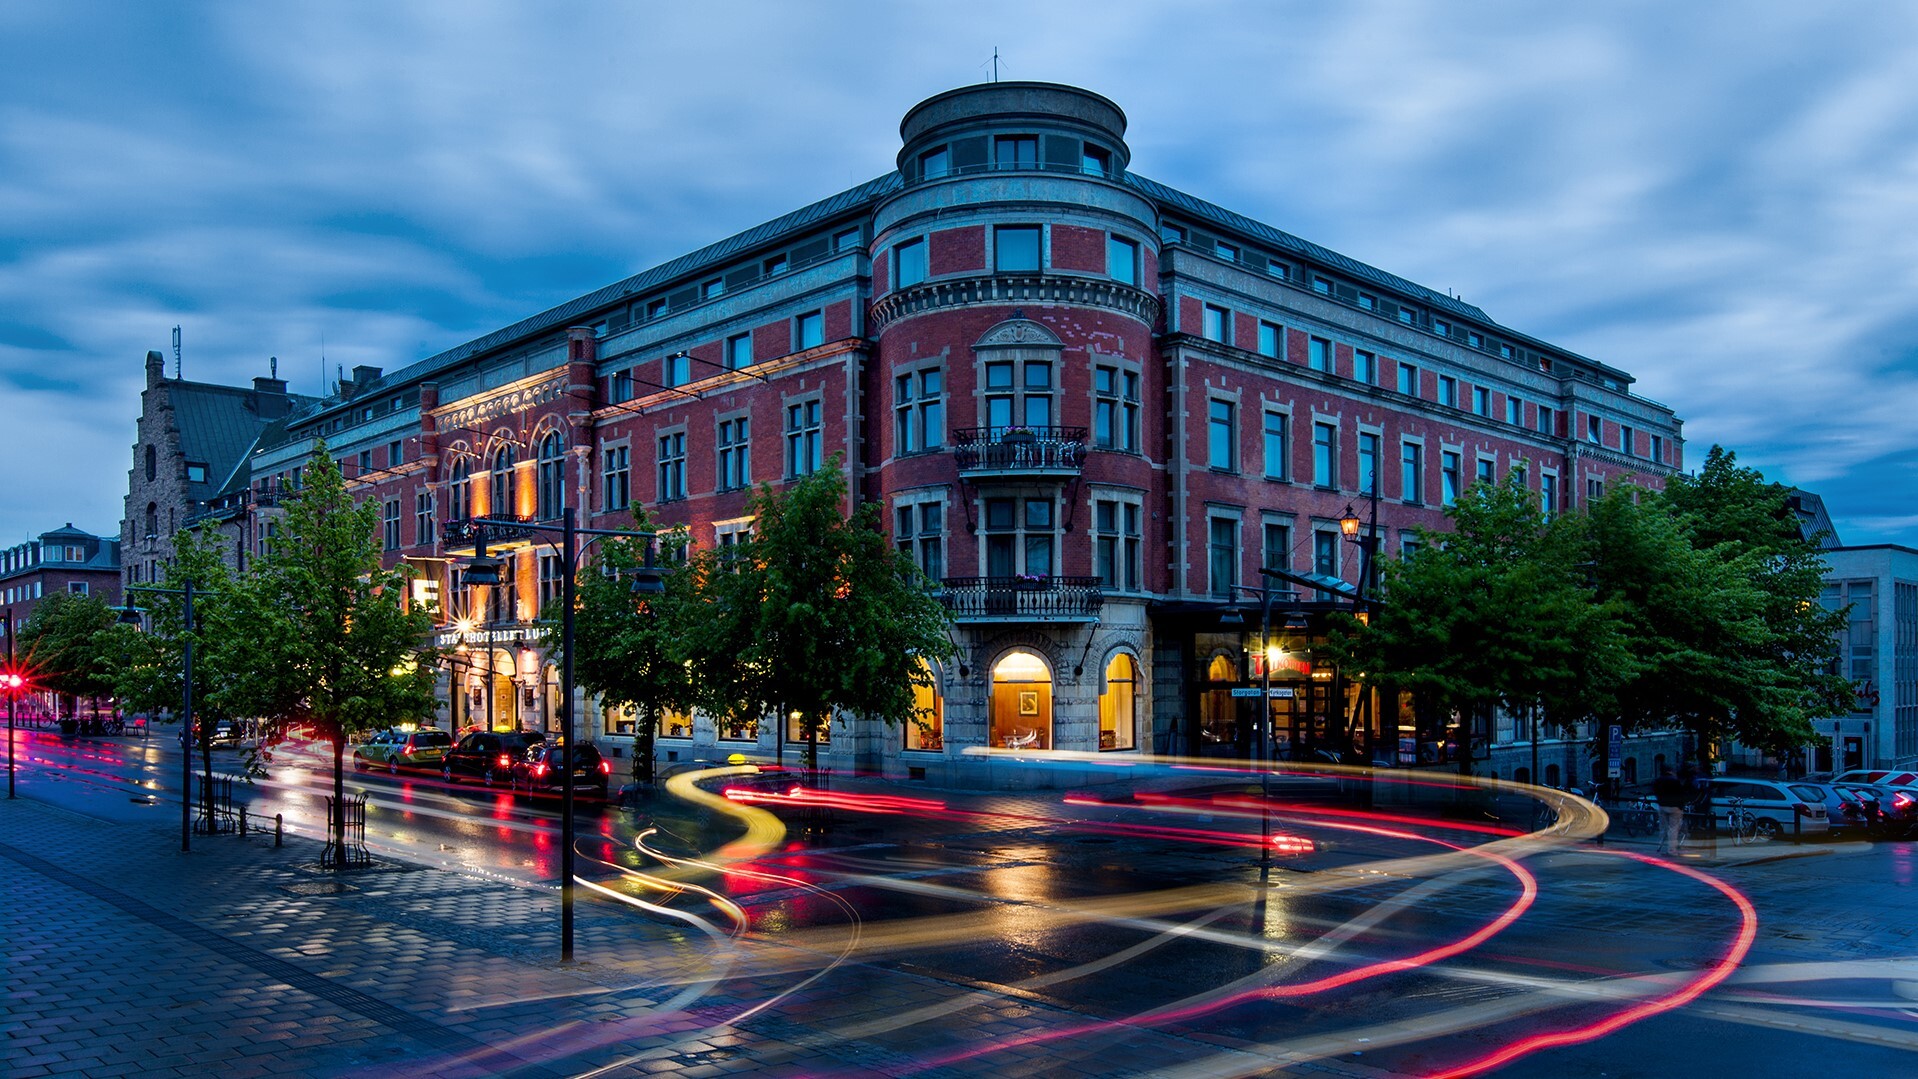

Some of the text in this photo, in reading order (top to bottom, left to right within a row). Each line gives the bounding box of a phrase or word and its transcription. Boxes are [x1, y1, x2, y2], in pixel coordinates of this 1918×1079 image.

[1251, 655, 1311, 675] TLKOTTEN
[1233, 689, 1260, 697] Storgatan
[1612, 727, 1619, 741] P
